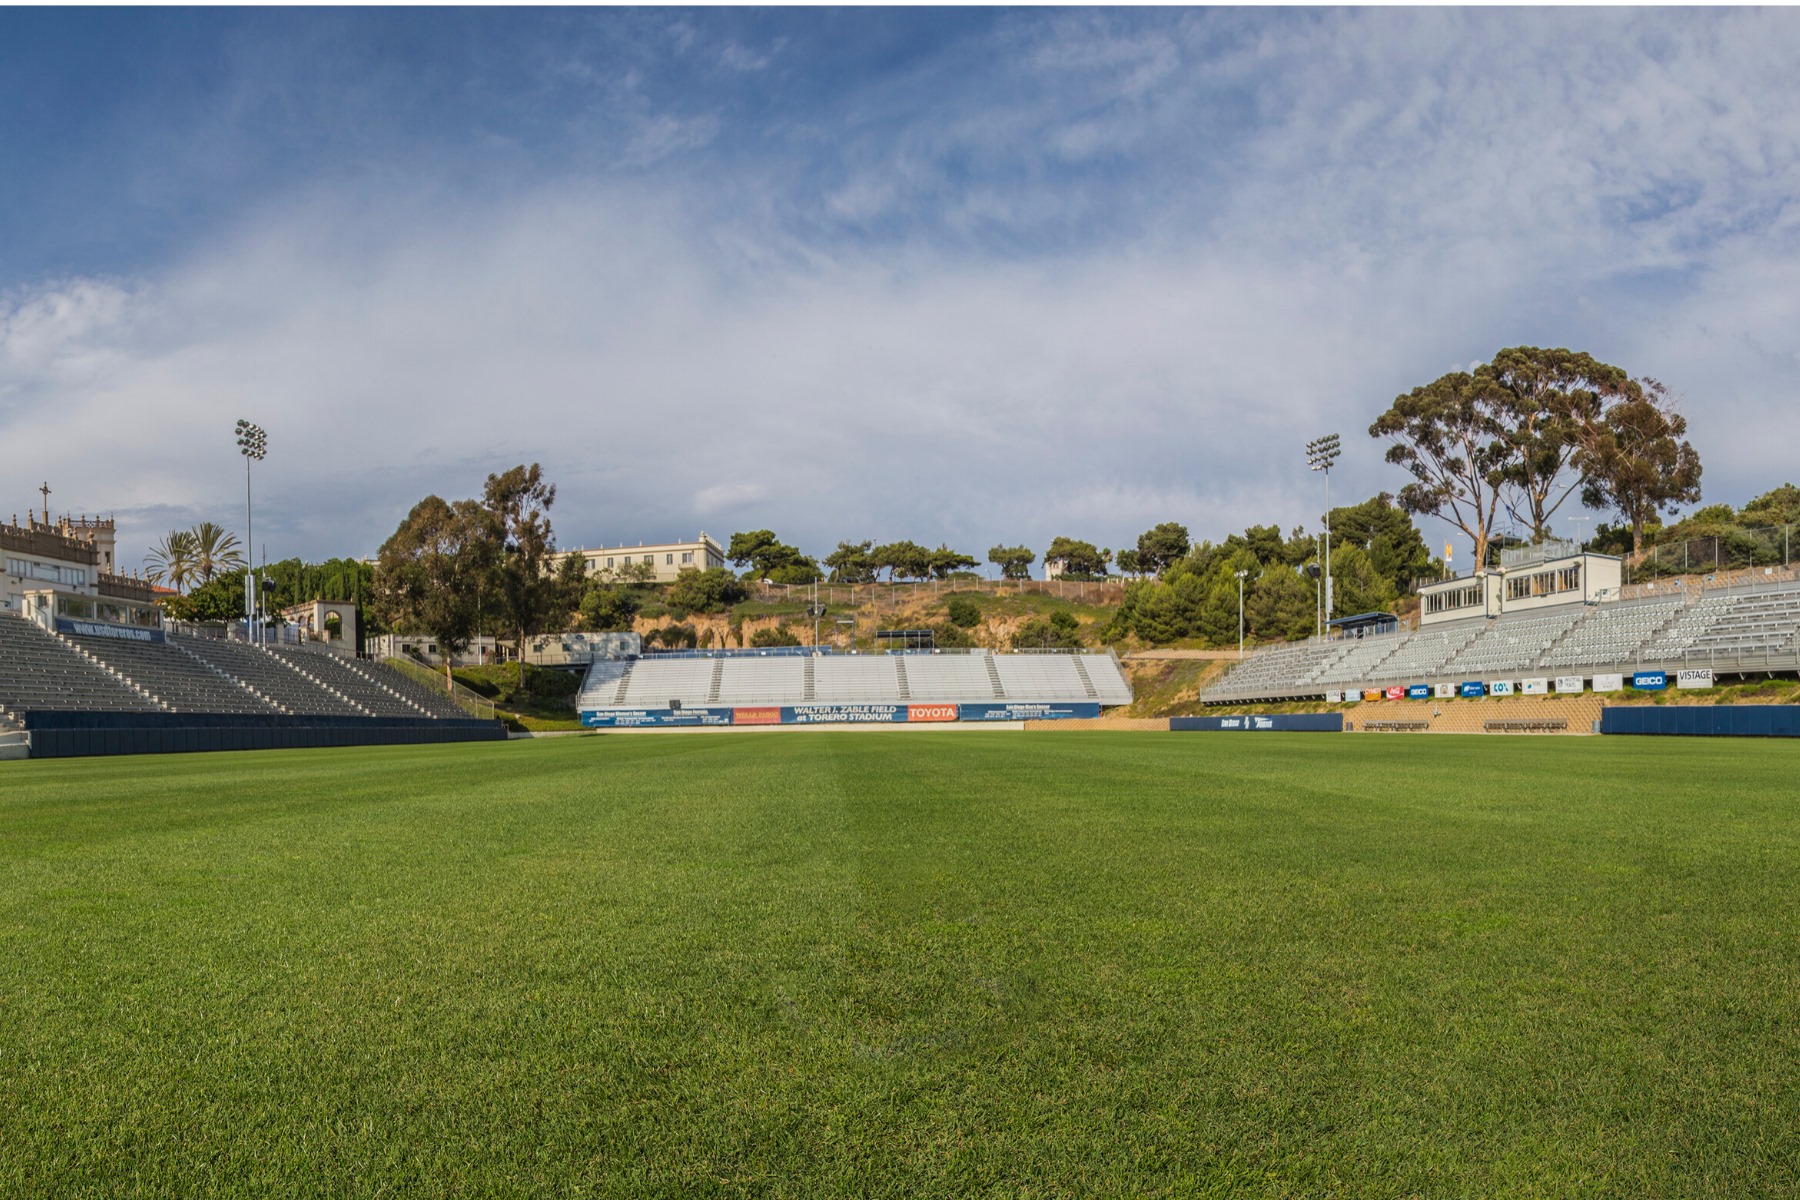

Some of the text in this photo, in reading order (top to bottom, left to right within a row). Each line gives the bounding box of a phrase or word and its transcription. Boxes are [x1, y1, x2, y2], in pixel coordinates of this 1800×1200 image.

[1679, 670, 1711, 680] VISTAGE
[1636, 676, 1663, 686] GEICO
[795, 706, 831, 715] WALTER
[840, 705, 869, 714] ZABLE
[871, 705, 897, 713] FIELD
[910, 707, 955, 717] TOYOTA
[797, 713, 893, 722] at TORERO STADIUM
